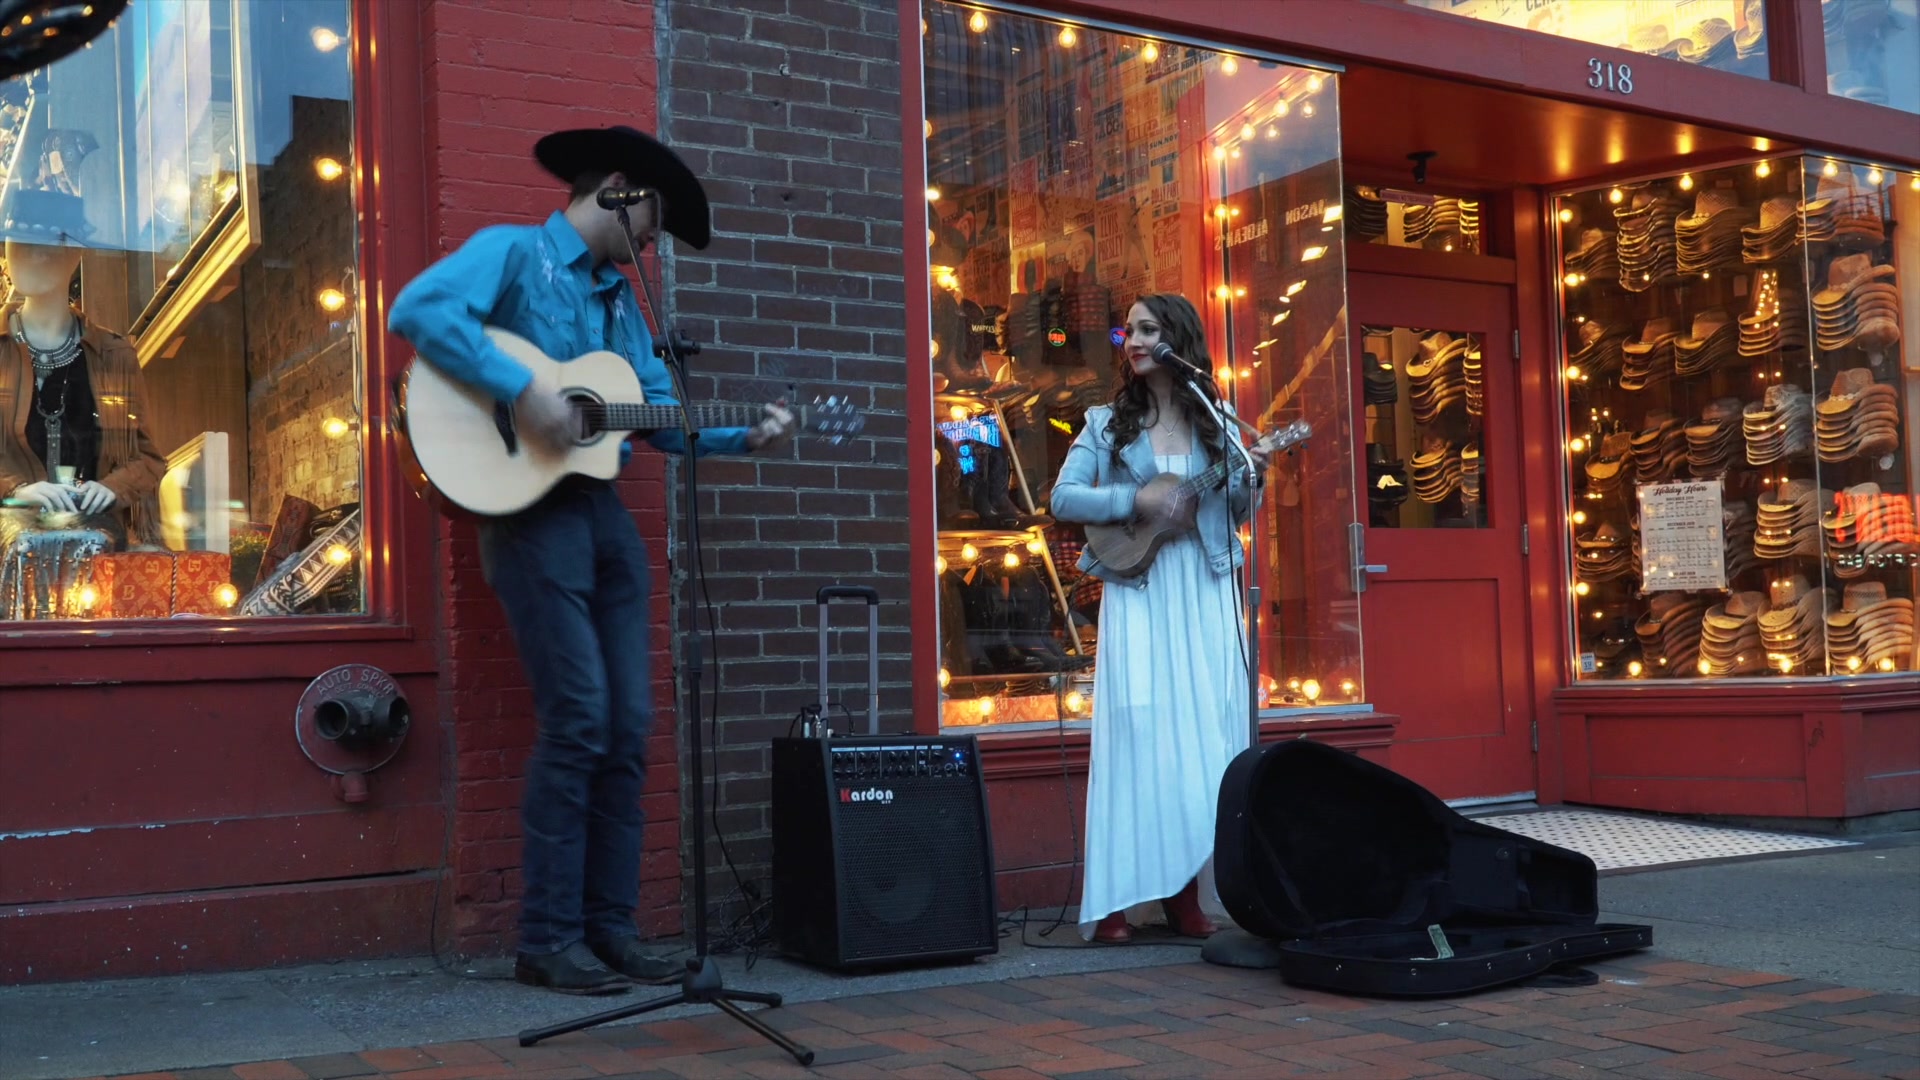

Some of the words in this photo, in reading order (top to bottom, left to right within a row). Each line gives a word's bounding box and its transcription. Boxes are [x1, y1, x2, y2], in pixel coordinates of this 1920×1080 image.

[1587, 57, 1634, 95] 318
[1100, 212, 1119, 238] ELVIS
[1097, 233, 1123, 263] PRESLEY
[1652, 485, 1682, 496] Holiday
[1683, 483, 1708, 495] Hours
[316, 669, 351, 696] AUTO
[361, 668, 395, 695] SPKR
[841, 787, 893, 803] Kardon
